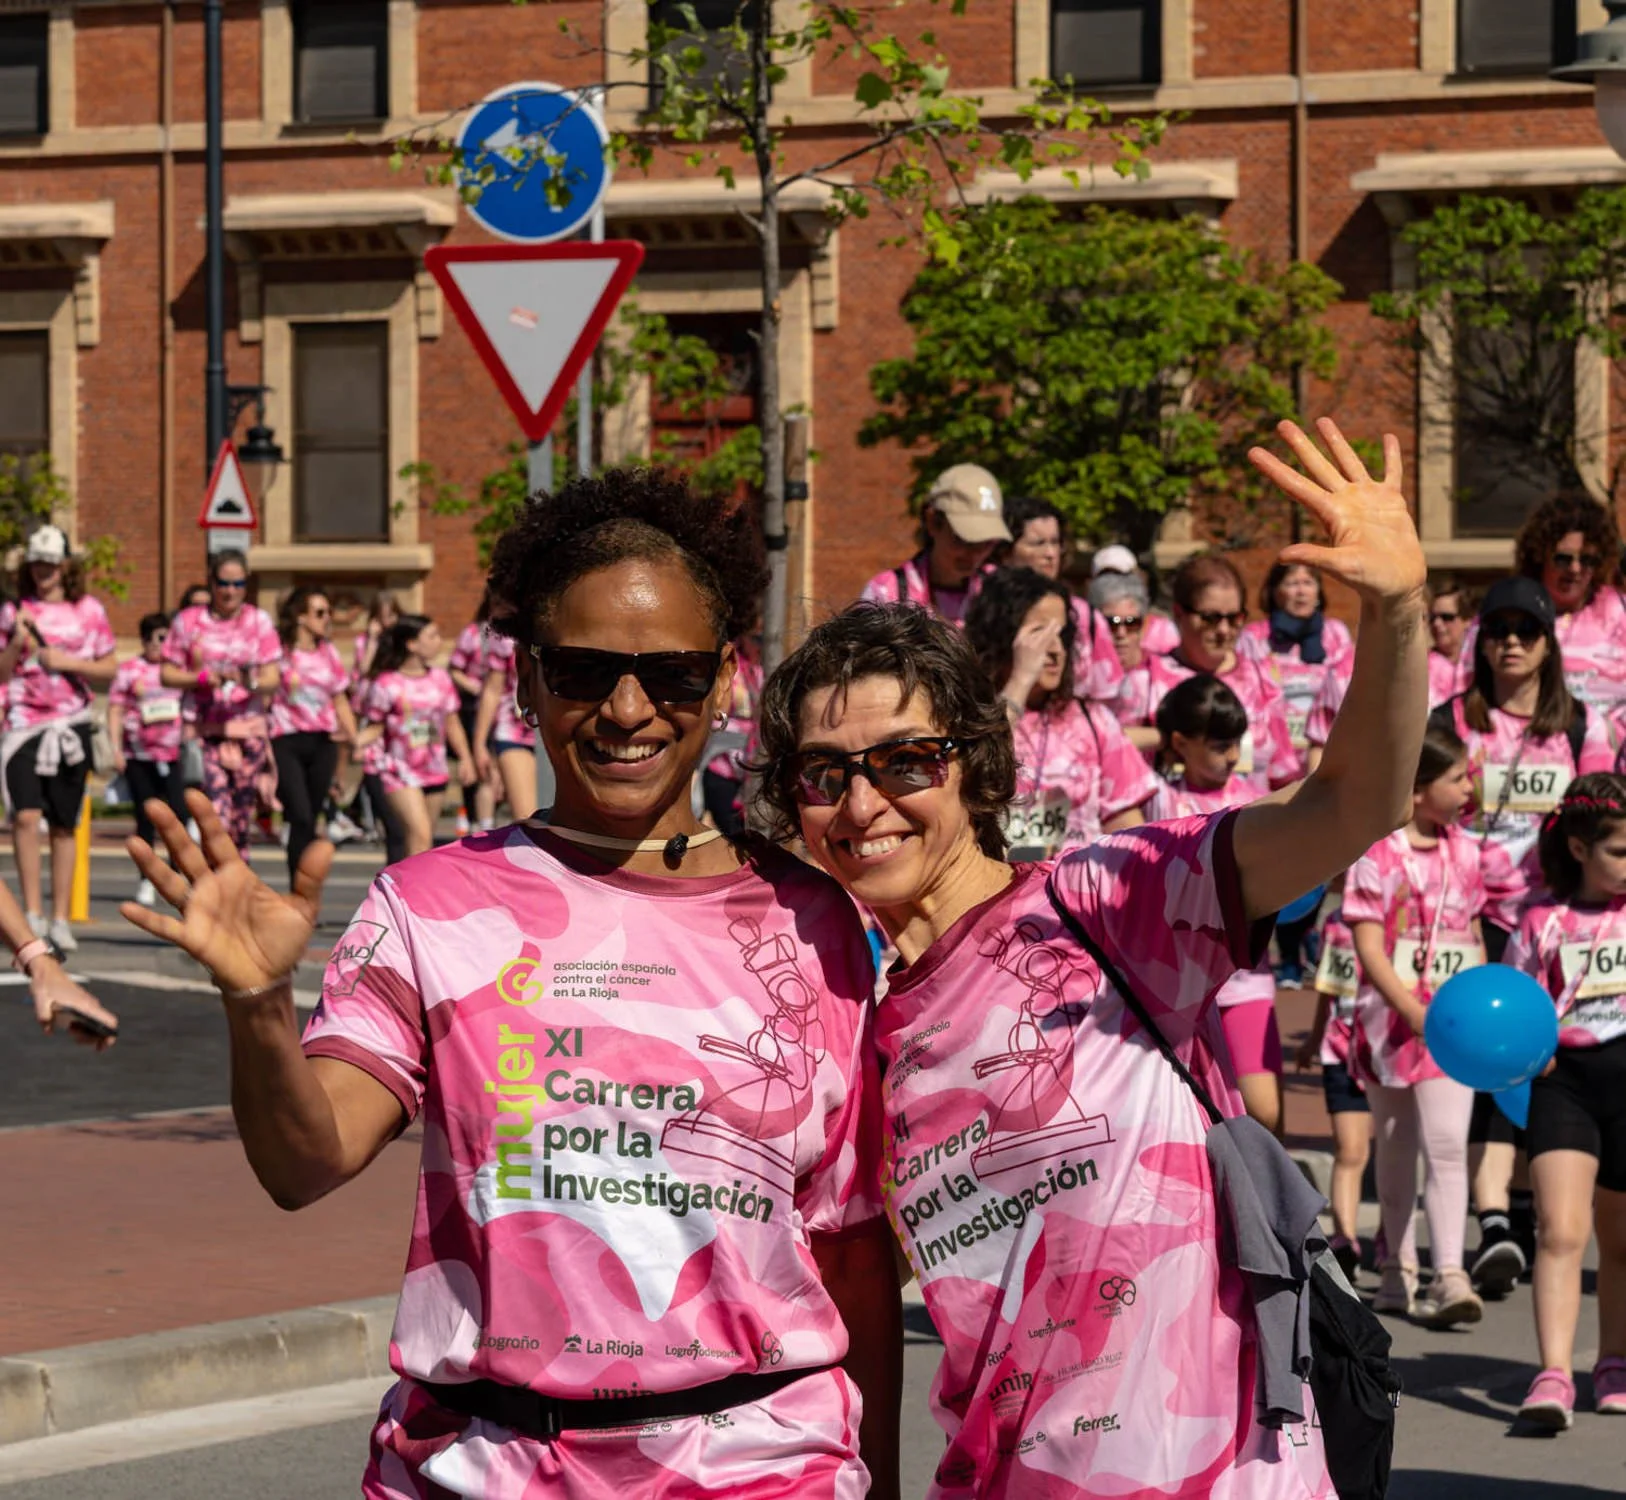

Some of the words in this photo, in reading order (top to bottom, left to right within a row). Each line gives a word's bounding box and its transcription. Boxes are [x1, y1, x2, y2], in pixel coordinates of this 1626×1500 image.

[553, 960, 618, 971] asociación
[621, 962, 676, 976] española
[553, 974, 593, 984] contra
[595, 974, 606, 985] el
[609, 974, 651, 986] cáncer
[553, 988, 569, 997] en
[571, 987, 586, 997] La
[589, 987, 619, 1000] Rioja
[544, 1028, 583, 1057] XI
[544, 1069, 697, 1112] Carrera
[484, 1024, 548, 1200] mujer
[543, 1123, 608, 1160] por
[617, 1121, 652, 1159] la
[893, 1118, 988, 1187] Carrera
[543, 1165, 774, 1223] Investigación
[900, 1187, 944, 1238] por
[941, 1171, 978, 1202] la
[915, 1159, 1099, 1271] Investigación
[586, 1340, 603, 1354] La
[606, 1340, 644, 1358] Rioja
